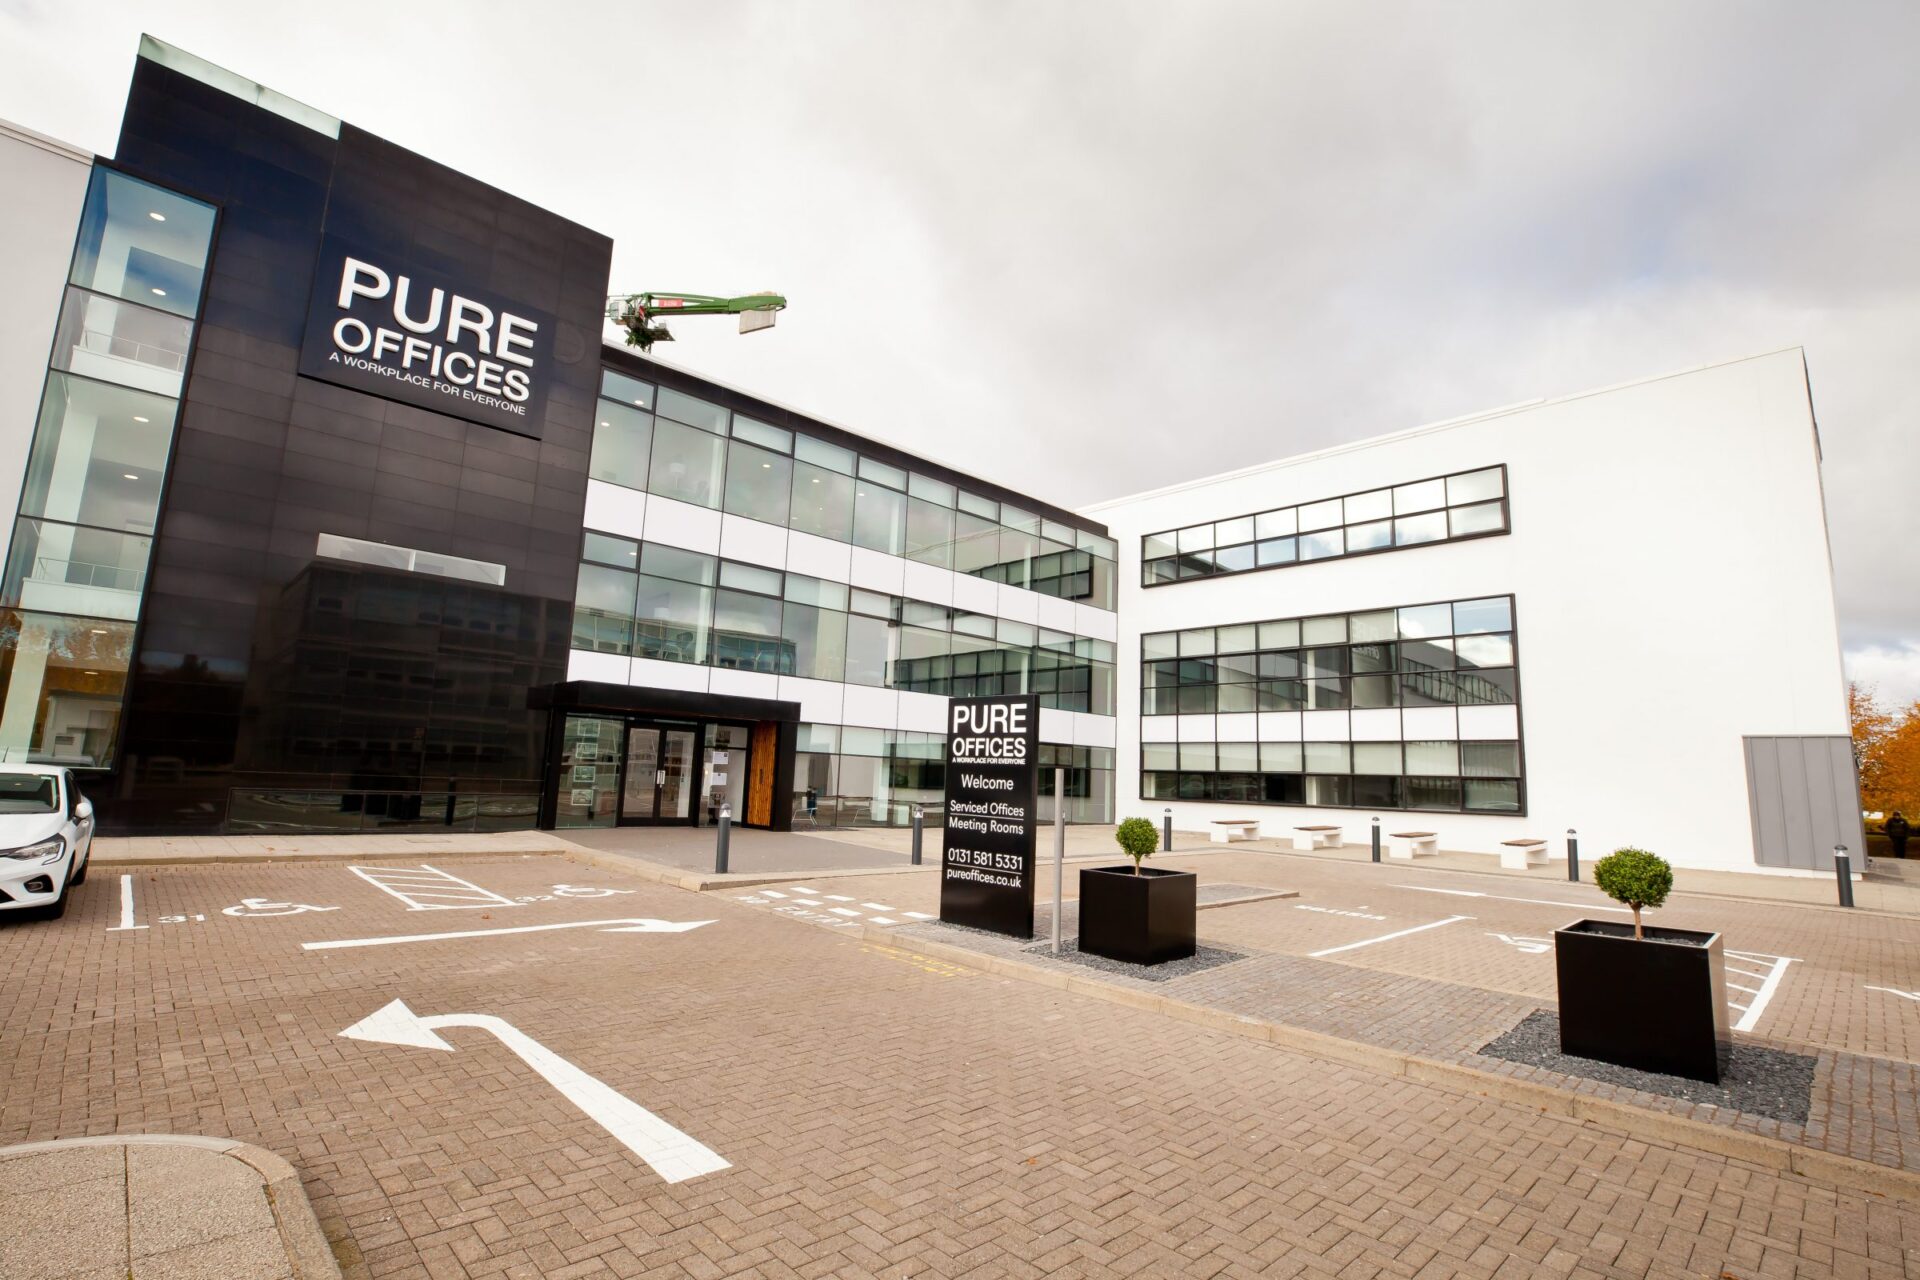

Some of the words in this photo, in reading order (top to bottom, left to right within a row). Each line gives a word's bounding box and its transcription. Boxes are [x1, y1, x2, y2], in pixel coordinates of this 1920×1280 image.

[338, 256, 538, 368] PURE
[333, 317, 530, 402] OFFICES
[329, 352, 340, 363] A
[344, 354, 431, 388] WORKPLACE
[433, 381, 460, 397] FOR
[462, 389, 526, 416] EVERYONE
[953, 703, 1028, 734] PURE
[952, 737, 1027, 758] OFFICES
[961, 773, 1014, 790] Welcome
[950, 799, 988, 814] Serviced
[990, 802, 1025, 817] Offices
[949, 816, 987, 834] Meeting
[990, 820, 1024, 835] Rooms
[948, 848, 971, 863] 0131
[973, 851, 992, 866] 581
[995, 853, 1023, 871] 5331
[946, 868, 1022, 888] pureoffices.co.uk
[773, 906, 862, 927] ENTRY
